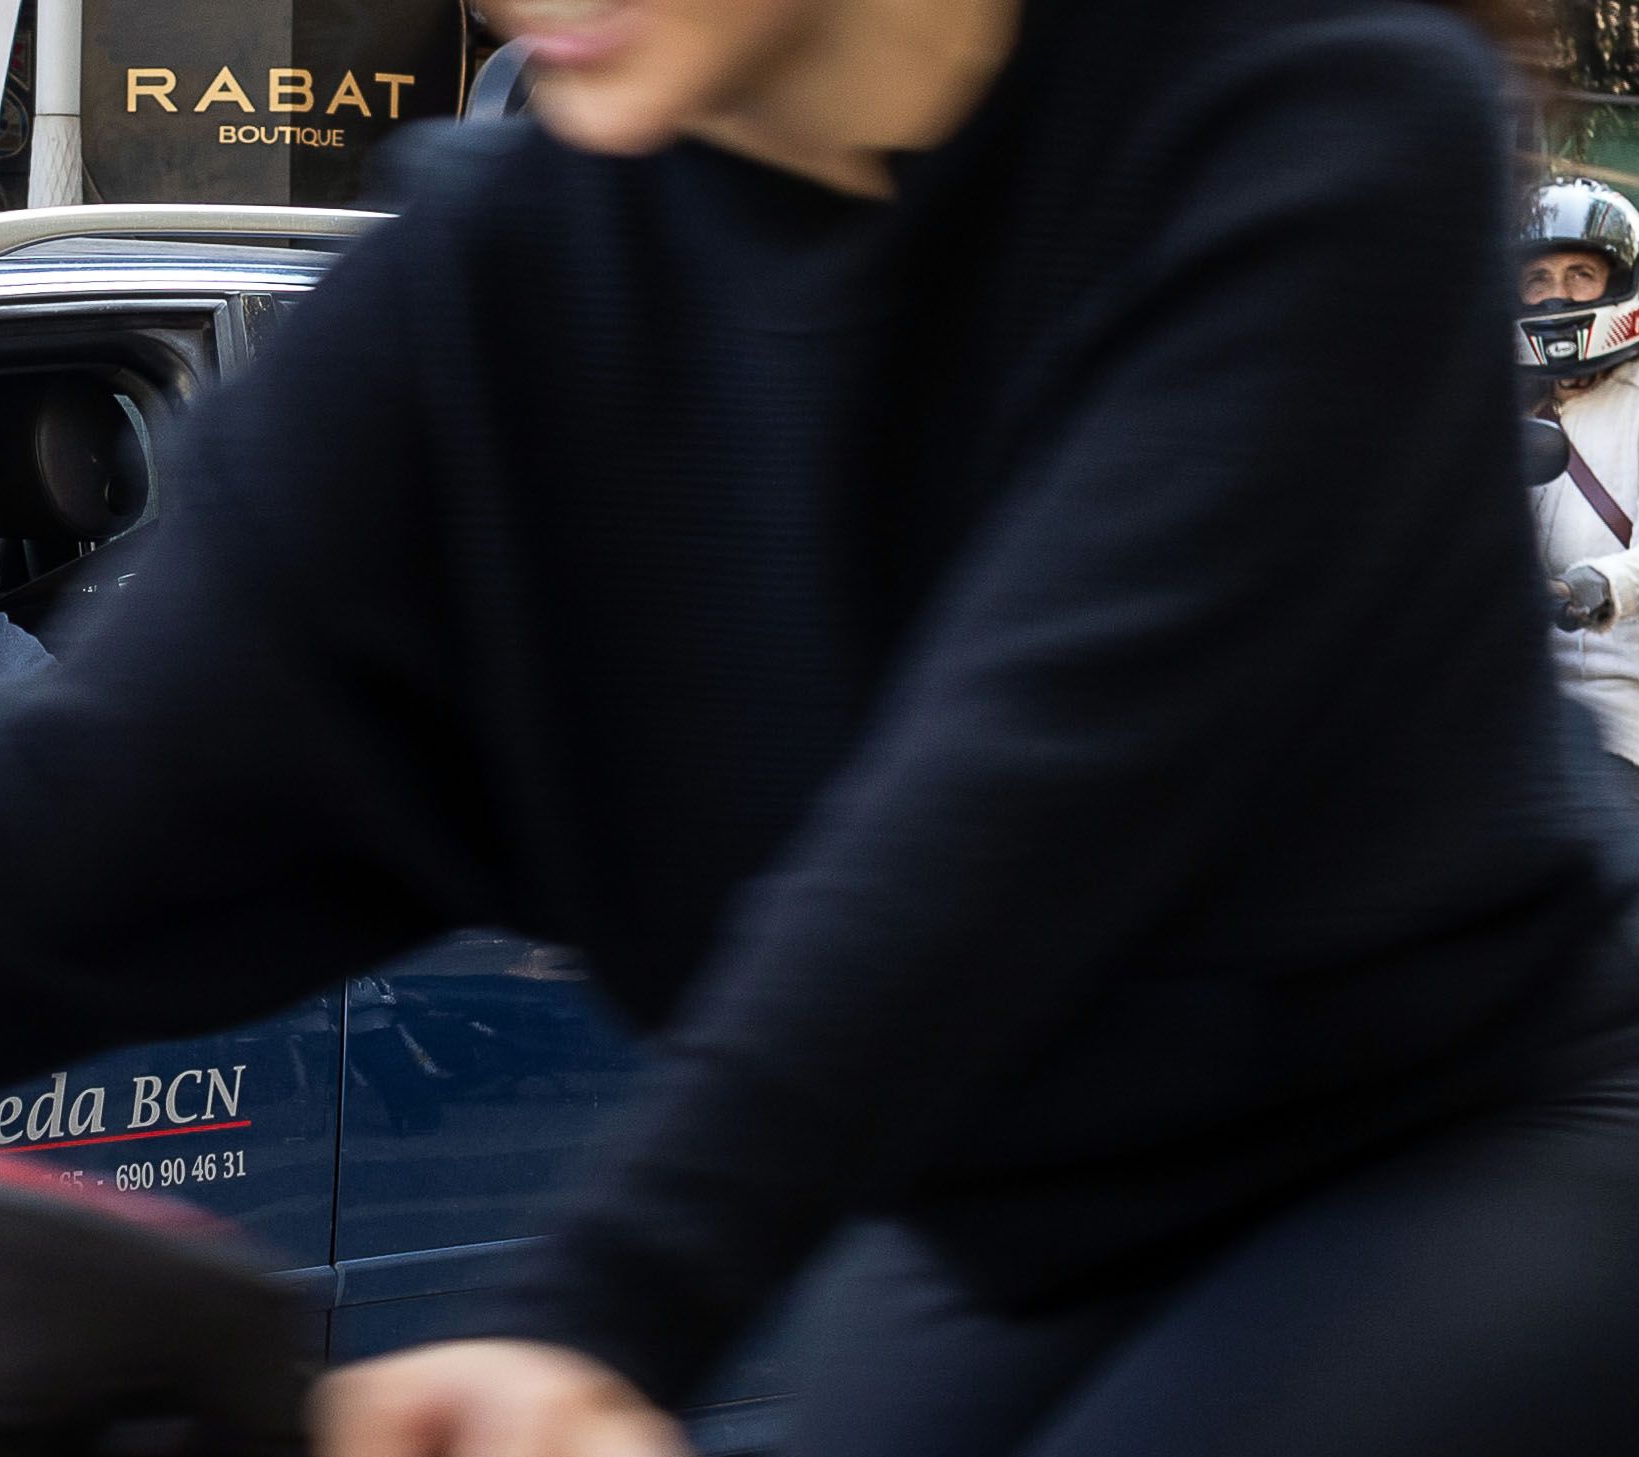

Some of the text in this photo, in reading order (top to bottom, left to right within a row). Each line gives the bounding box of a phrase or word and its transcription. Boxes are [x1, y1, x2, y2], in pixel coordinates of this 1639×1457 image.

[126, 65, 415, 119] RABAT
[218, 125, 345, 148] BOUTIQUE
[127, 1065, 247, 1129] BCN
[115, 1161, 155, 1192] 690
[160, 1157, 186, 1187] 90
[191, 1154, 217, 1182] 46
[223, 1150, 247, 1178] 31
